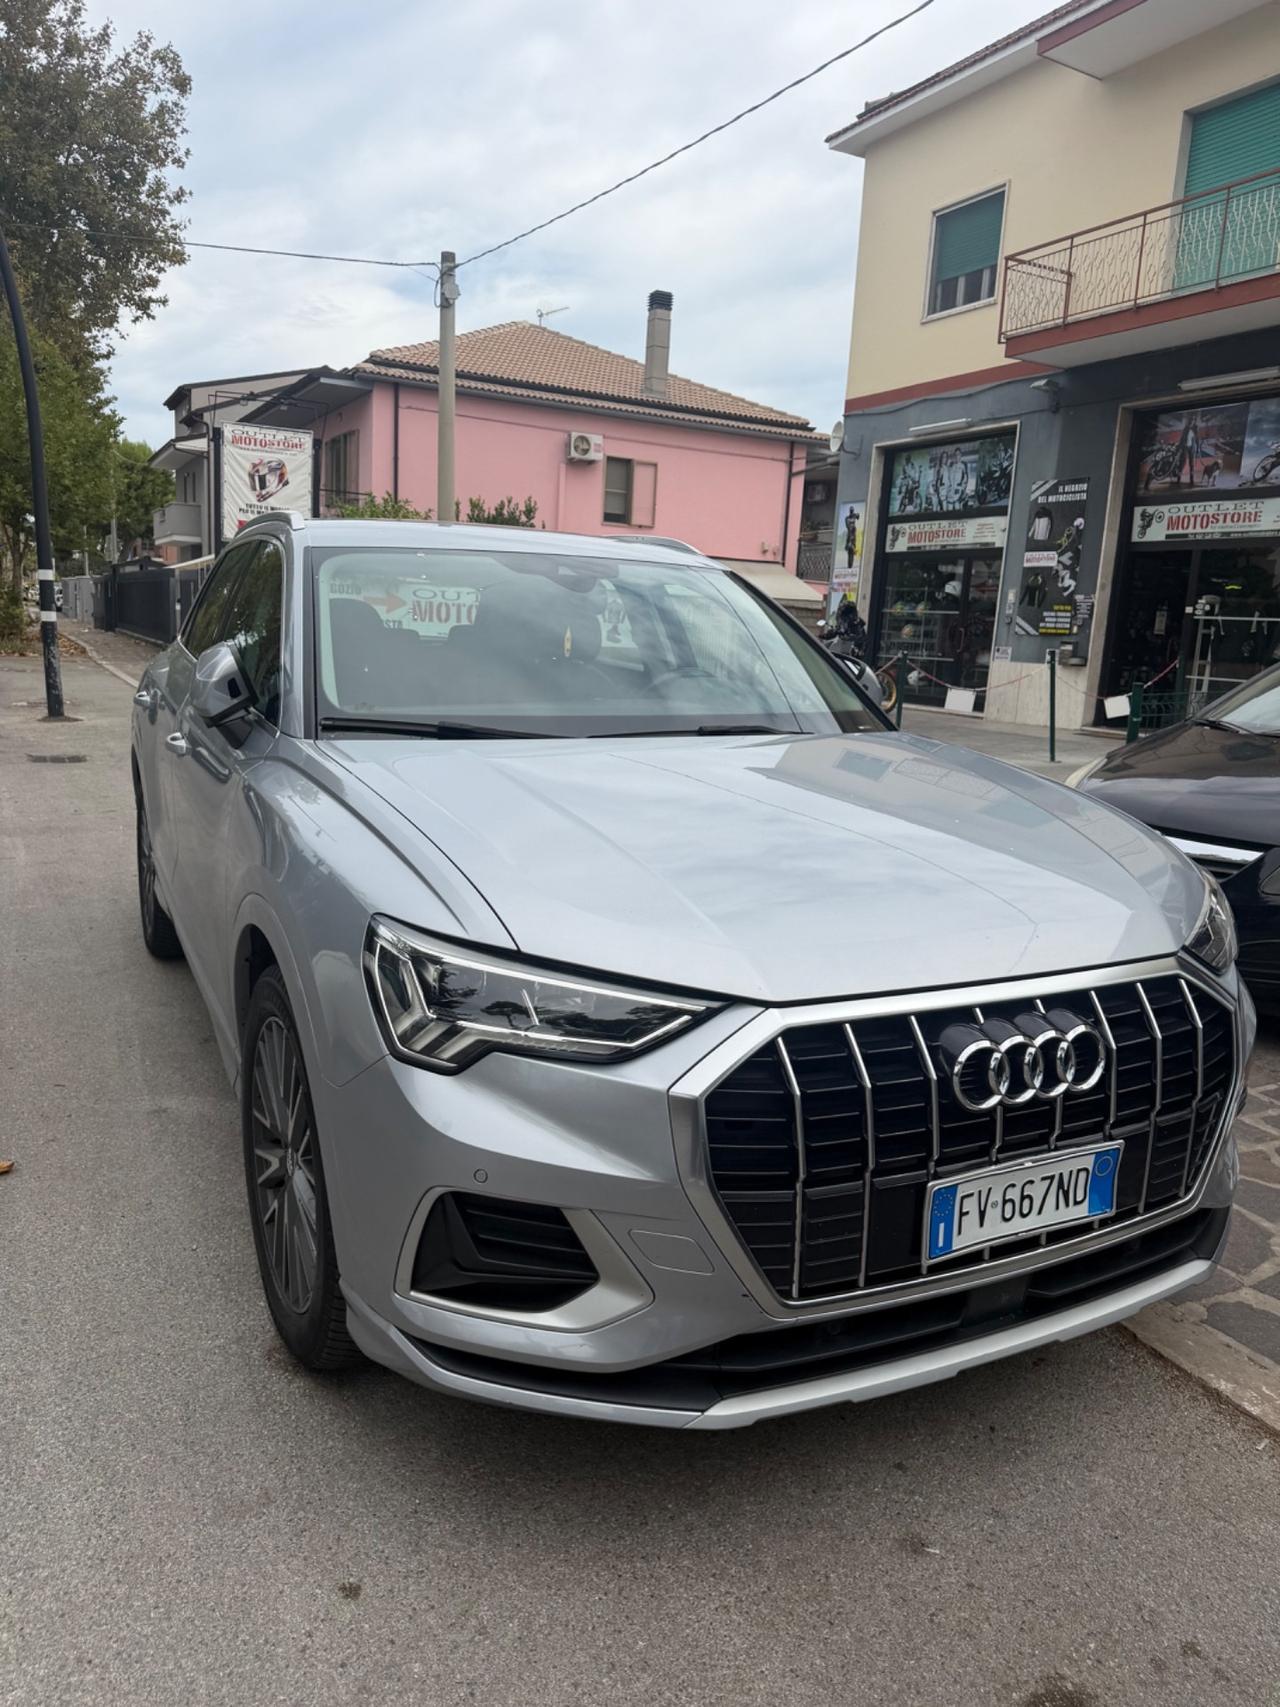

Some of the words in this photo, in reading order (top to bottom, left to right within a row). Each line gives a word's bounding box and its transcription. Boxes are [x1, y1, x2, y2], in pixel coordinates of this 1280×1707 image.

[231, 435, 304, 449] MOTOSTORE
[1168, 501, 1264, 514] OUTLET
[908, 520, 968, 531] OUTLET
[1167, 511, 1263, 531] MOTOSTORE
[907, 528, 967, 544] MOTOSTORE
